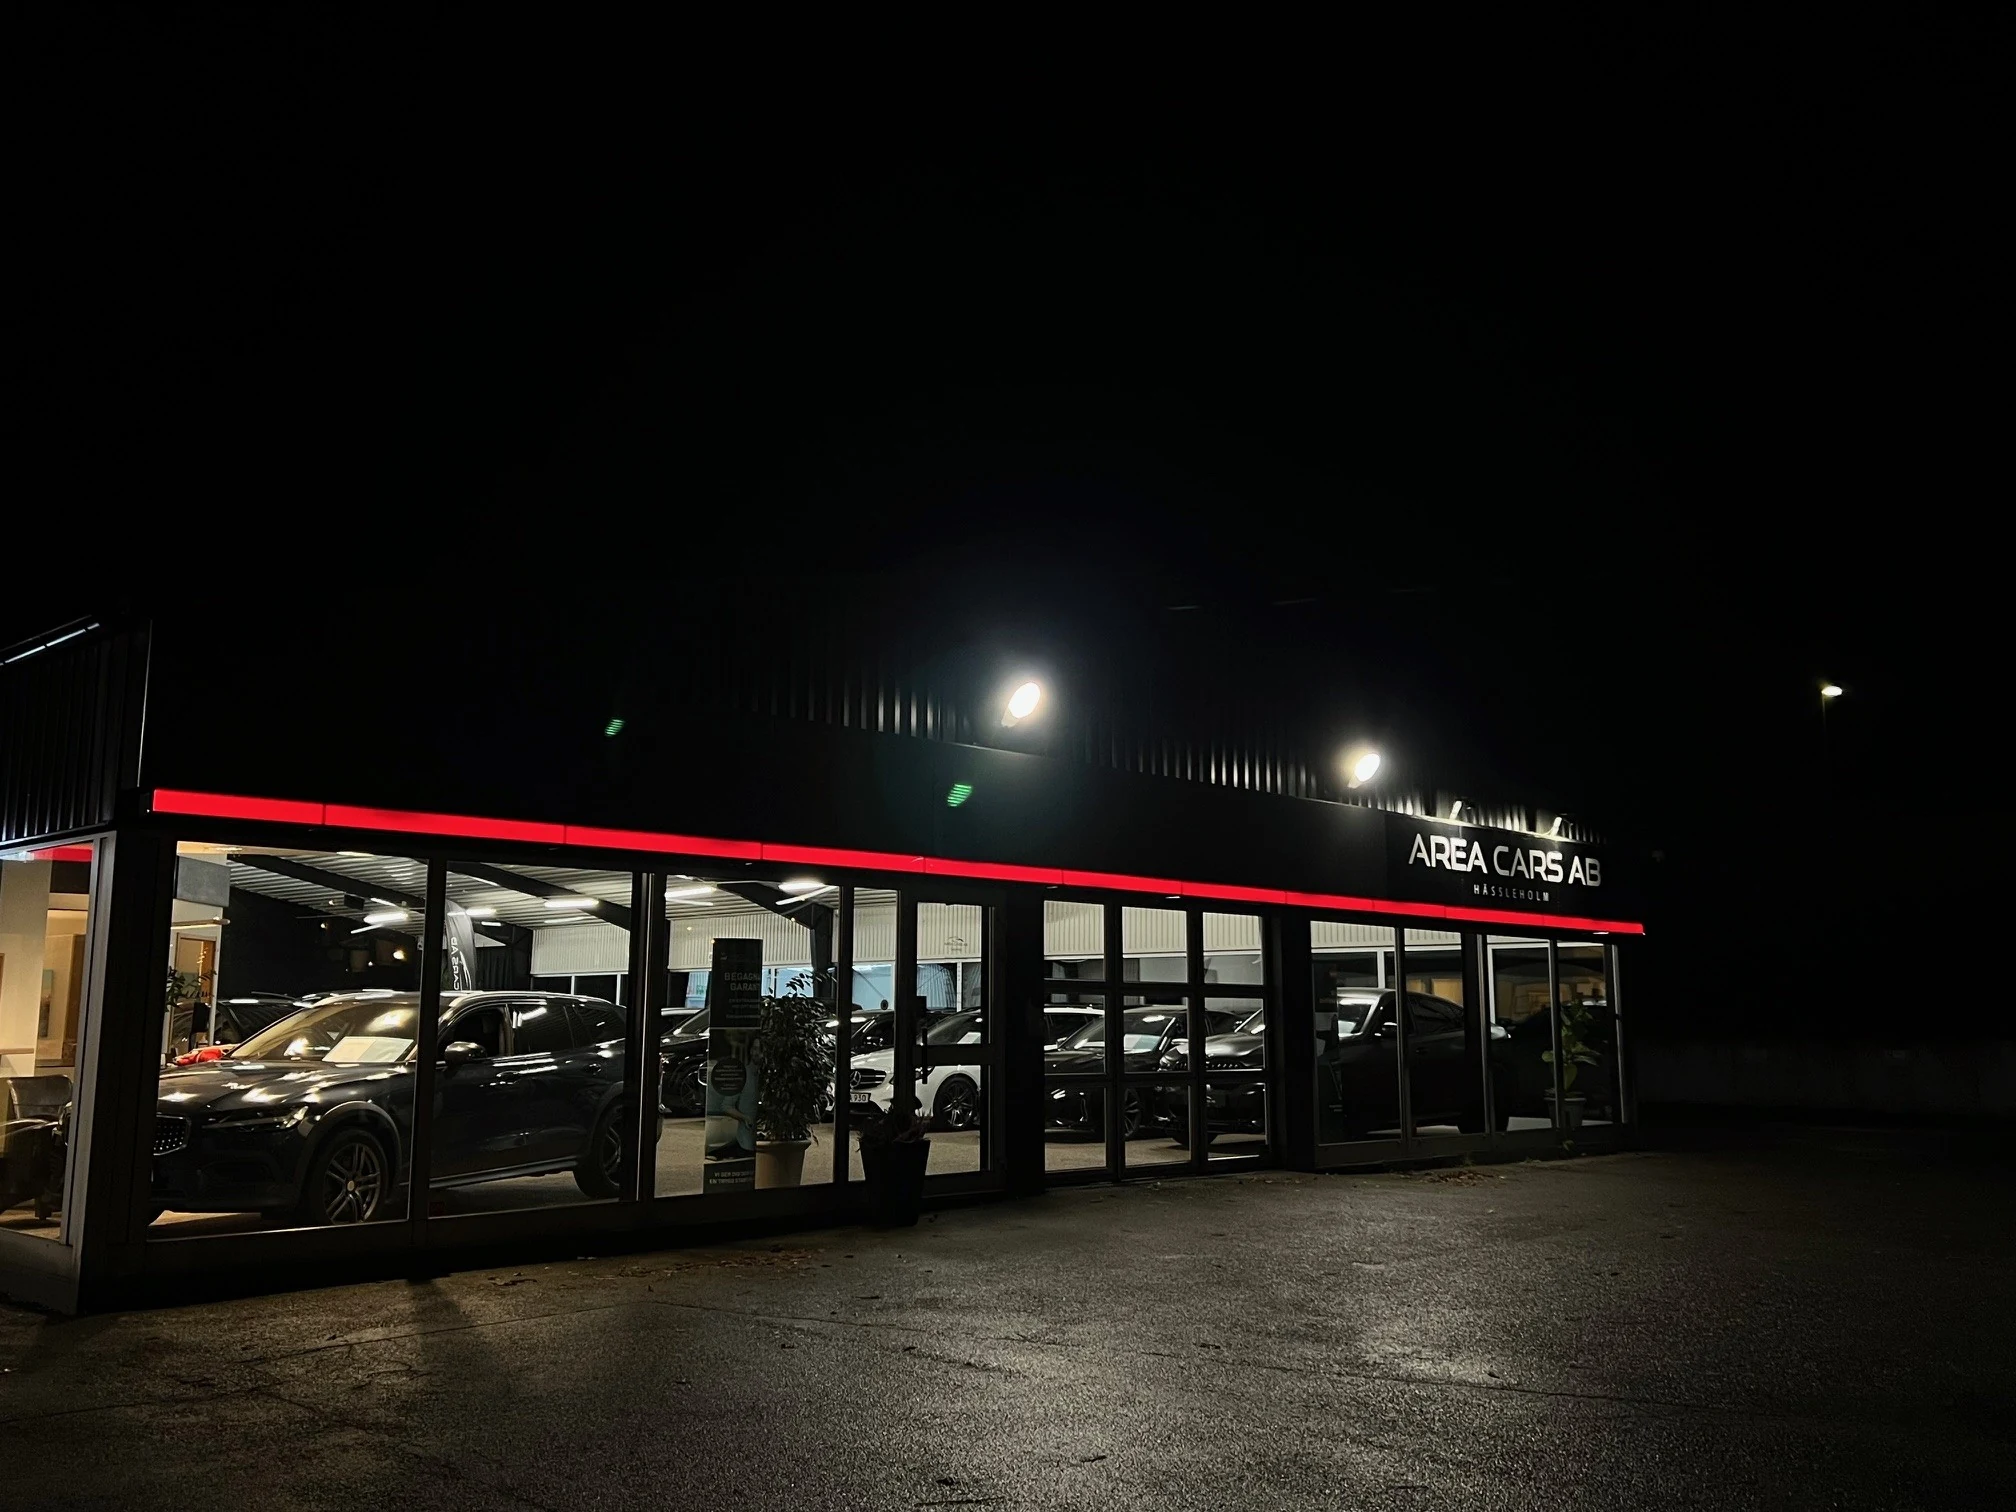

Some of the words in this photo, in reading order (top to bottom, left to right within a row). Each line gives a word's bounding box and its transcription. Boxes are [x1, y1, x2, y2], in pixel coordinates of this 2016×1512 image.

[1408, 833, 1488, 874] AREA
[1493, 845, 1564, 883] CARS
[1568, 855, 1602, 887] AB
